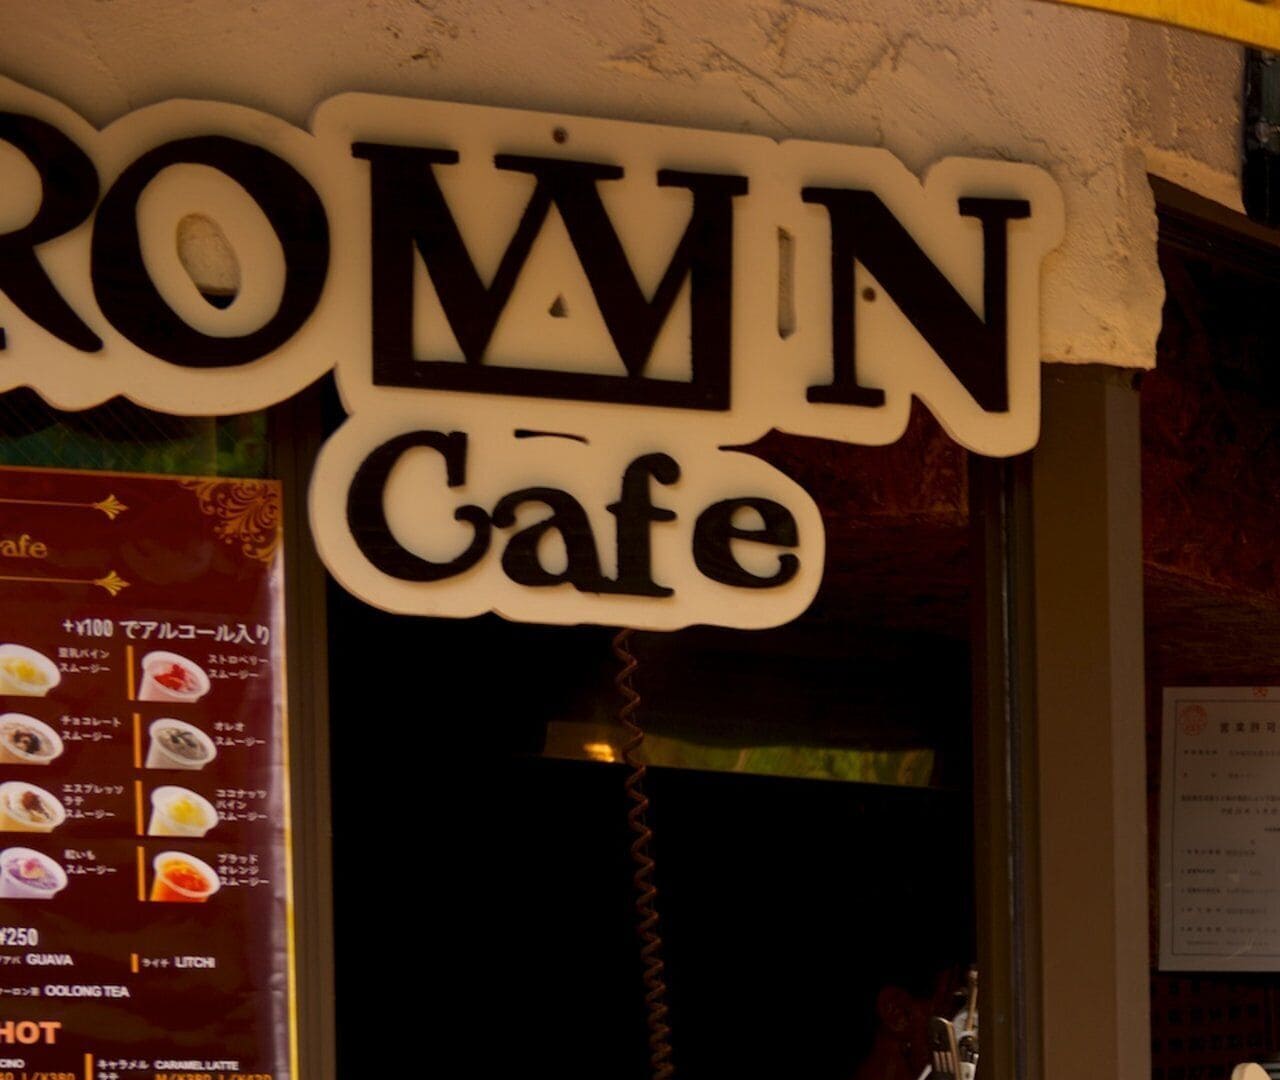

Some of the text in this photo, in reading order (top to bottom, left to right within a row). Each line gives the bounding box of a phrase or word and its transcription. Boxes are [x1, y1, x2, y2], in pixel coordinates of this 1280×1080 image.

[347, 431, 800, 598] Cafe
[120, 621, 270, 645] でアルコール入り
[60, 715, 122, 727] チョコレート
[26, 953, 74, 966] GUAVA
[174, 956, 216, 969] LITCHI
[44, 985, 102, 997] OOLONG
[103, 986, 131, 998] TEA
[0, 1021, 62, 1045] HOT
[97, 1059, 150, 1070] キャラメル
[204, 1060, 240, 1072] LATTE
